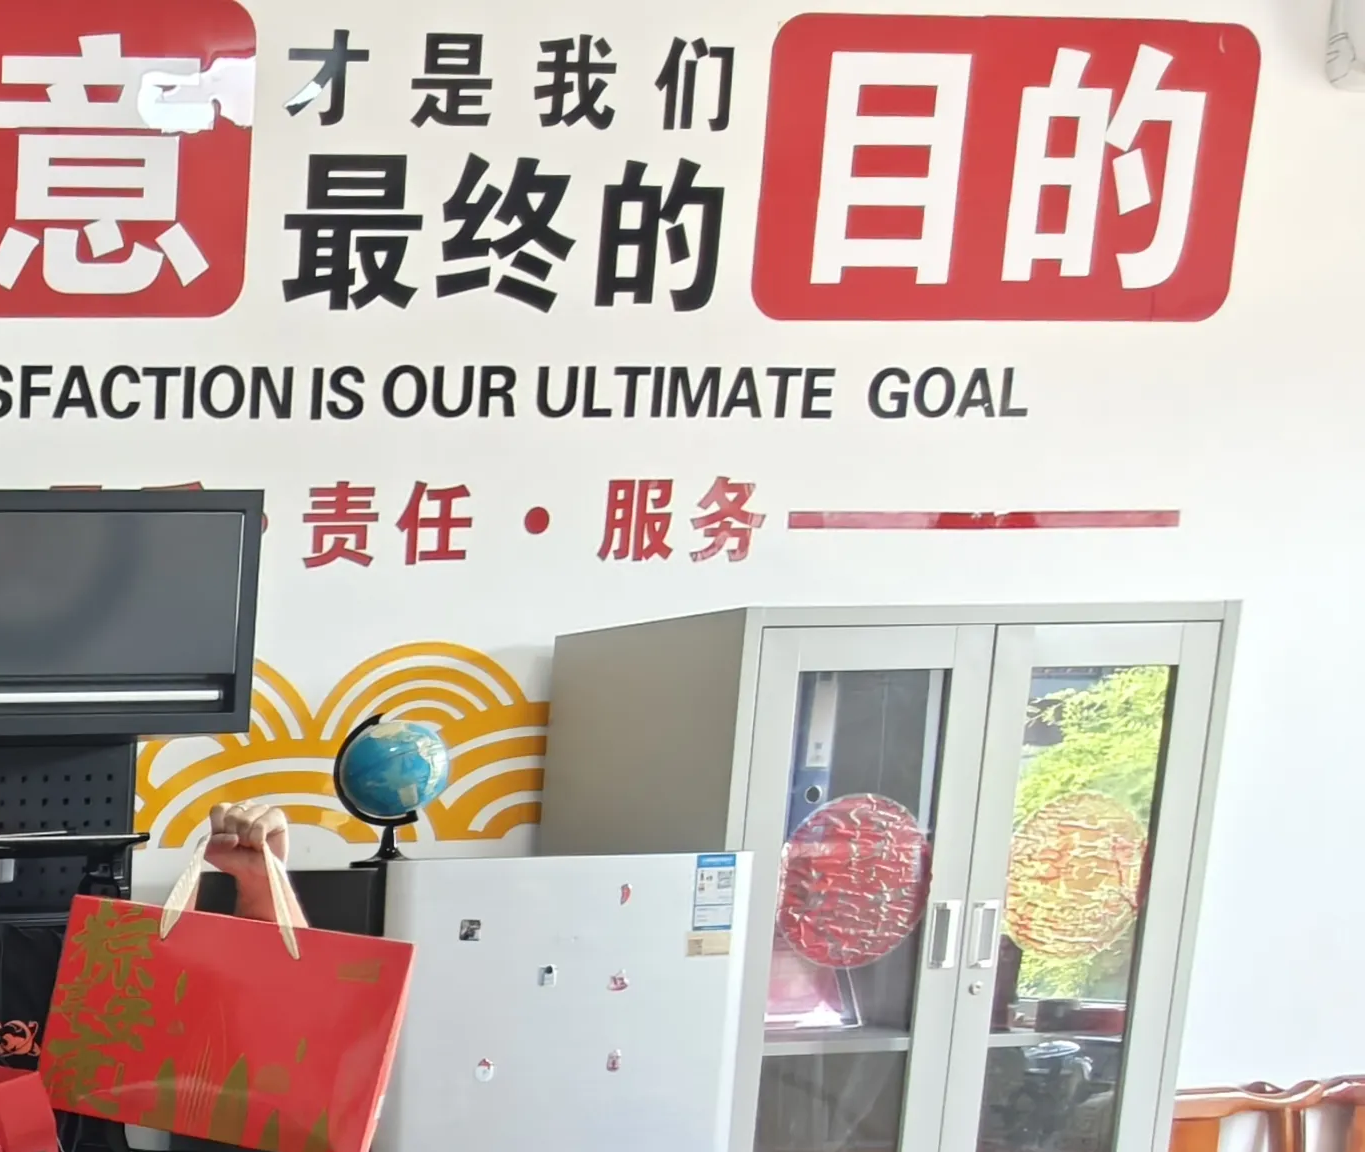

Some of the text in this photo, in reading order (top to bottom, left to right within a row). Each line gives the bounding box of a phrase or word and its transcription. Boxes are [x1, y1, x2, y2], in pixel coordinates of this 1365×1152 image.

[283, 29, 735, 132] 才是我们
[810, 43, 1207, 292] 目的
[281, 153, 725, 312] 最终的
[310, 366, 366, 420] IS
[382, 364, 517, 420] OUR
[535, 365, 835, 420] ULTIMATE
[868, 366, 1029, 420] GOAL
[302, 478, 767, 568] 责任 服务
